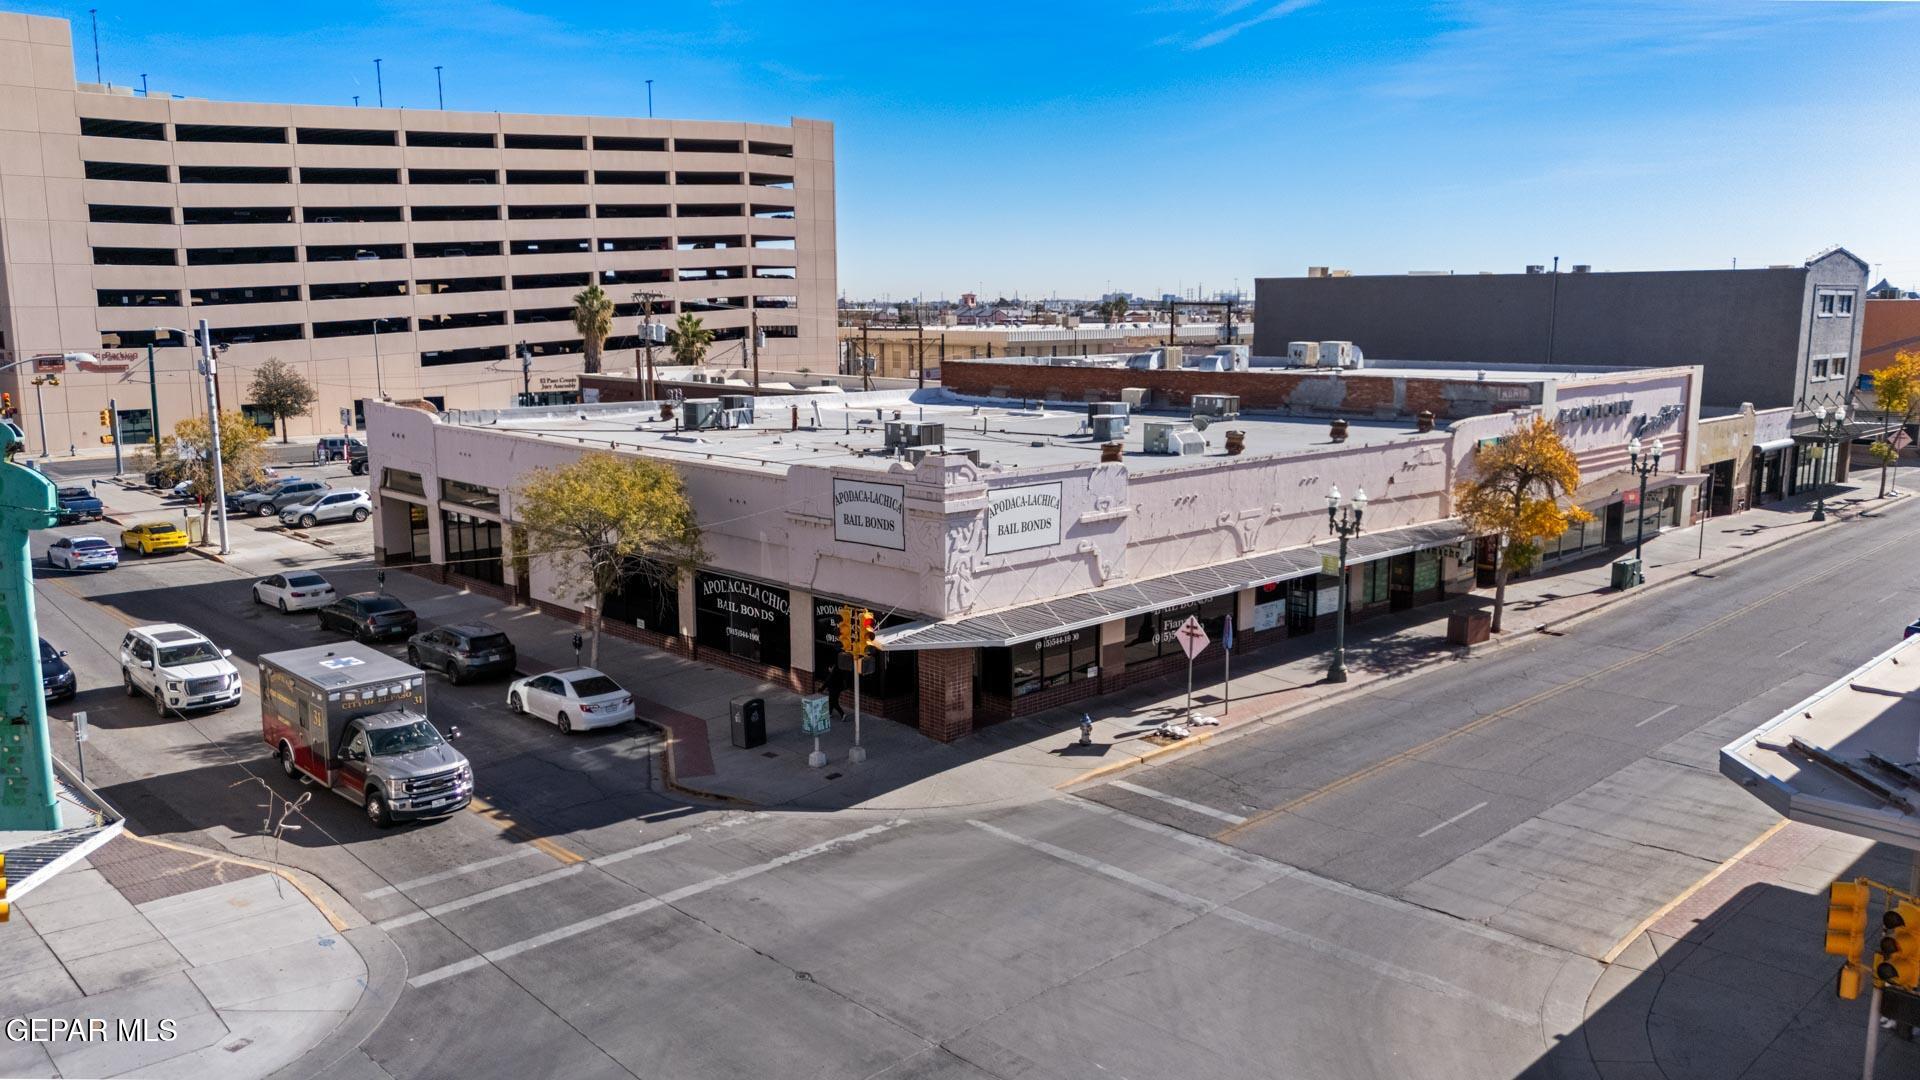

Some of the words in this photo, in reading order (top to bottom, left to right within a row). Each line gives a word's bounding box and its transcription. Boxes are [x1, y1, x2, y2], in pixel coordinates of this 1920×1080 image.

[835, 490, 902, 514] APODACA-LACHICA
[989, 493, 1060, 519] APODACA-LACHICA
[843, 513, 864, 528] BAIL
[865, 516, 895, 532] BONDS
[997, 522, 1019, 537] BAIL
[1021, 518, 1052, 535] BONDS
[717, 598, 738, 613] BAIL
[413, 696, 422, 705] 31
[313, 710, 322, 727] 31
